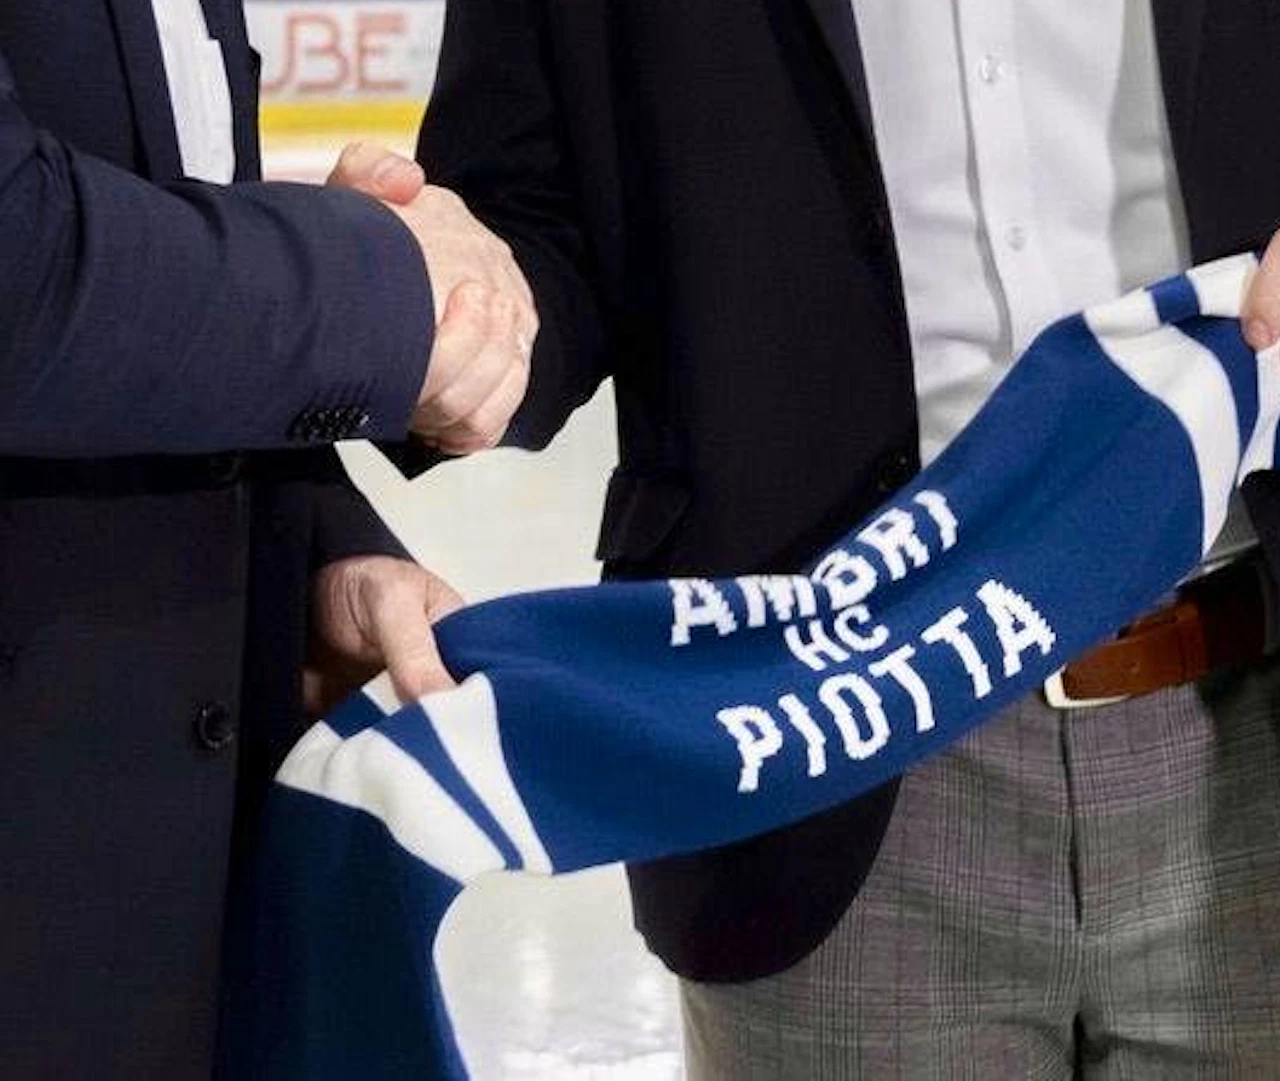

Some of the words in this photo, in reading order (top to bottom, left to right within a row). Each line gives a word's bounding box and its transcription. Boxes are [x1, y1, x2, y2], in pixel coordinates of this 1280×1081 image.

[668, 490, 958, 646] AMBRI
[784, 604, 890, 671] HC
[716, 578, 1056, 793] PIOTTA
